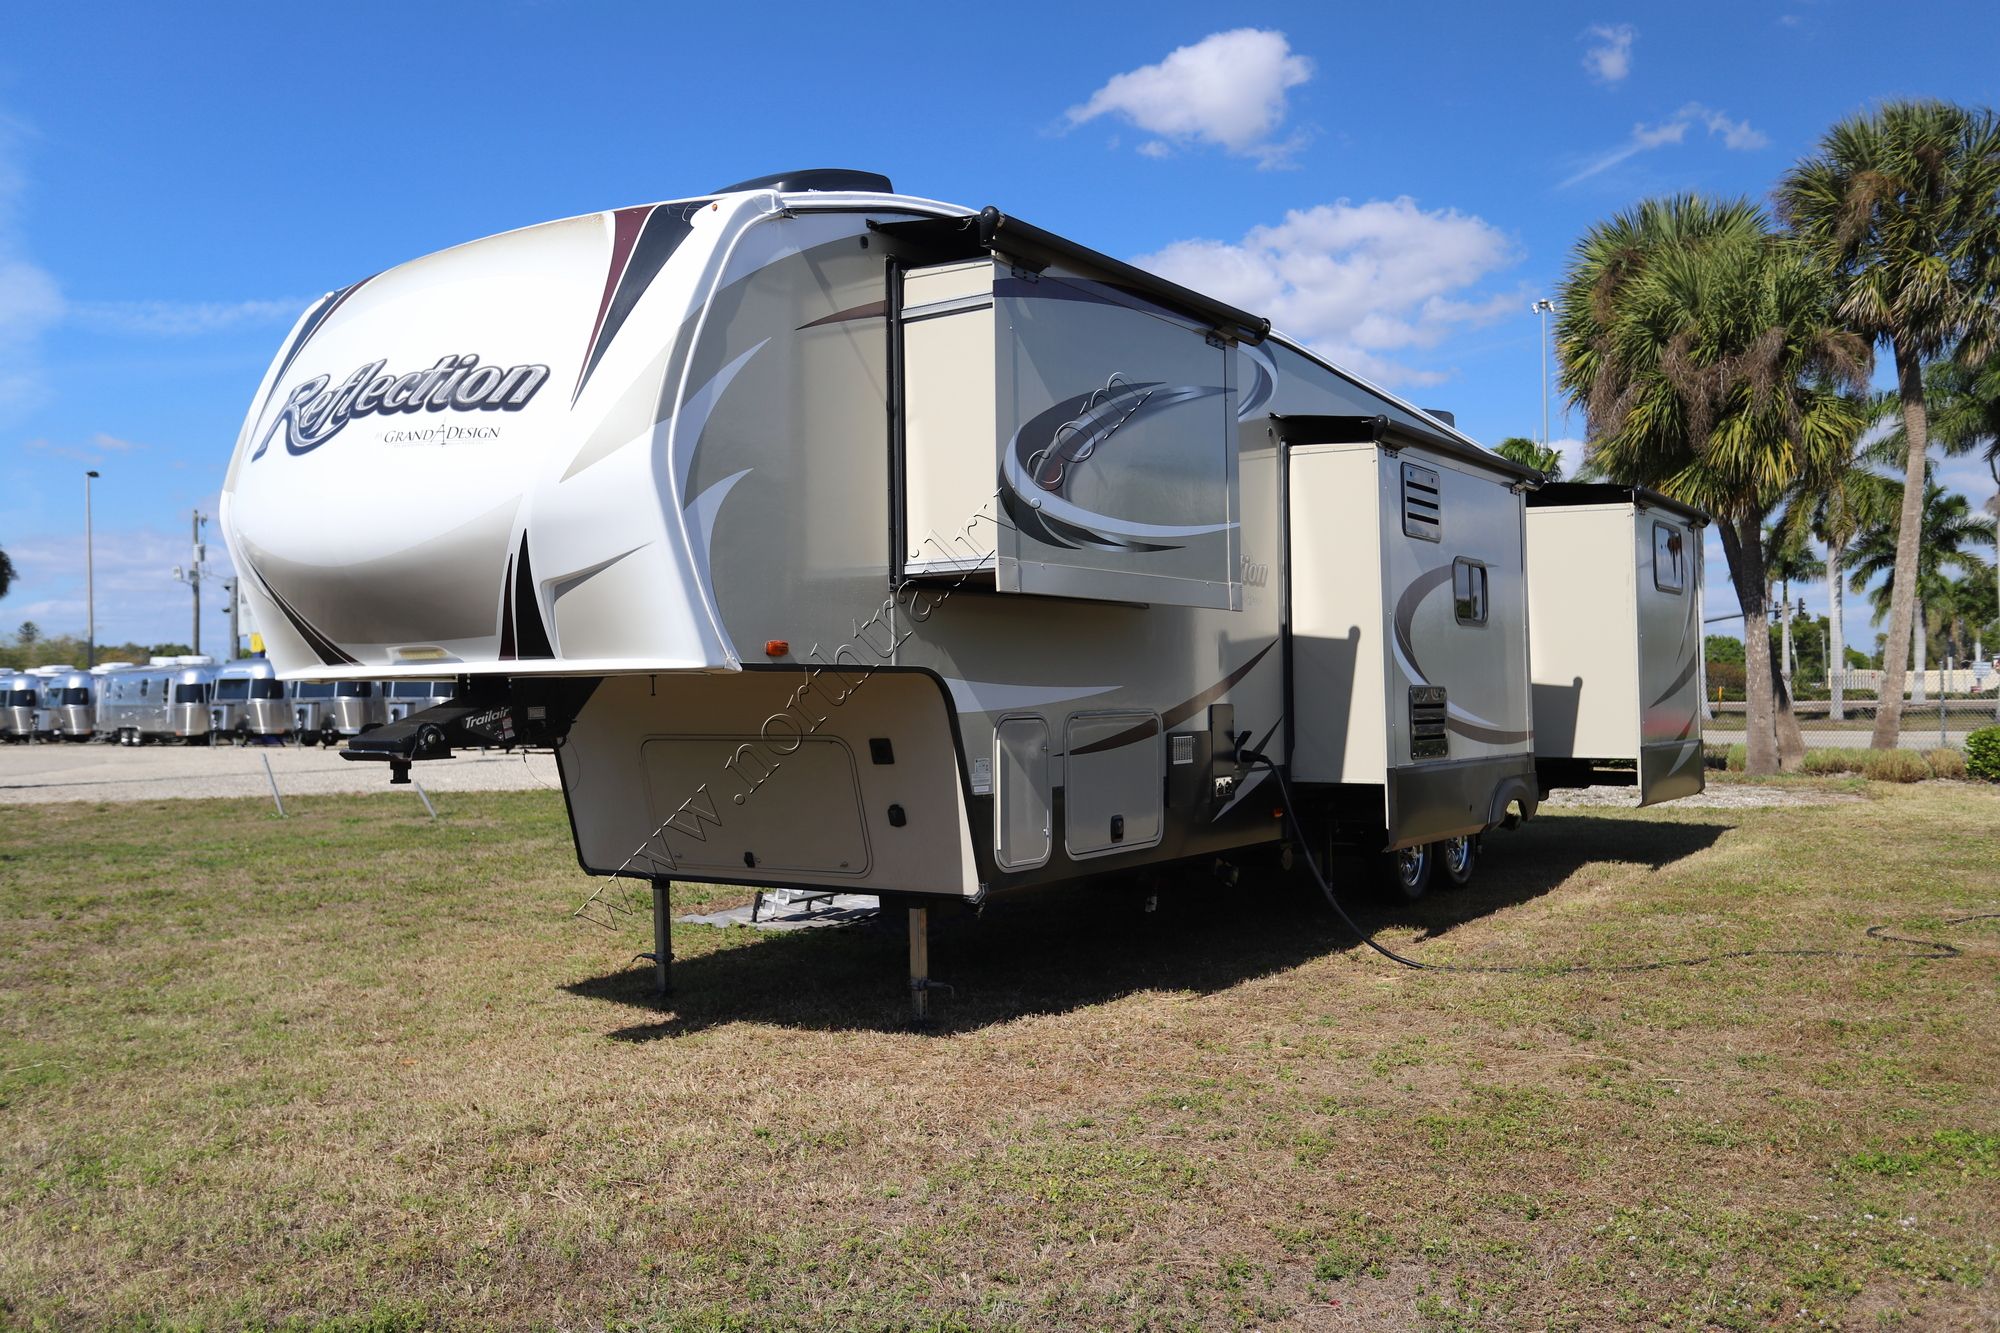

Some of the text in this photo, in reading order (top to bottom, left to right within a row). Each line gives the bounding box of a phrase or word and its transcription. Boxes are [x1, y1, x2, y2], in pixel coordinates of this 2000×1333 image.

[251, 354, 550, 462] Reflection
[384, 426, 501, 444] GRAND DESIGN
[465, 706, 510, 729] Trailair
